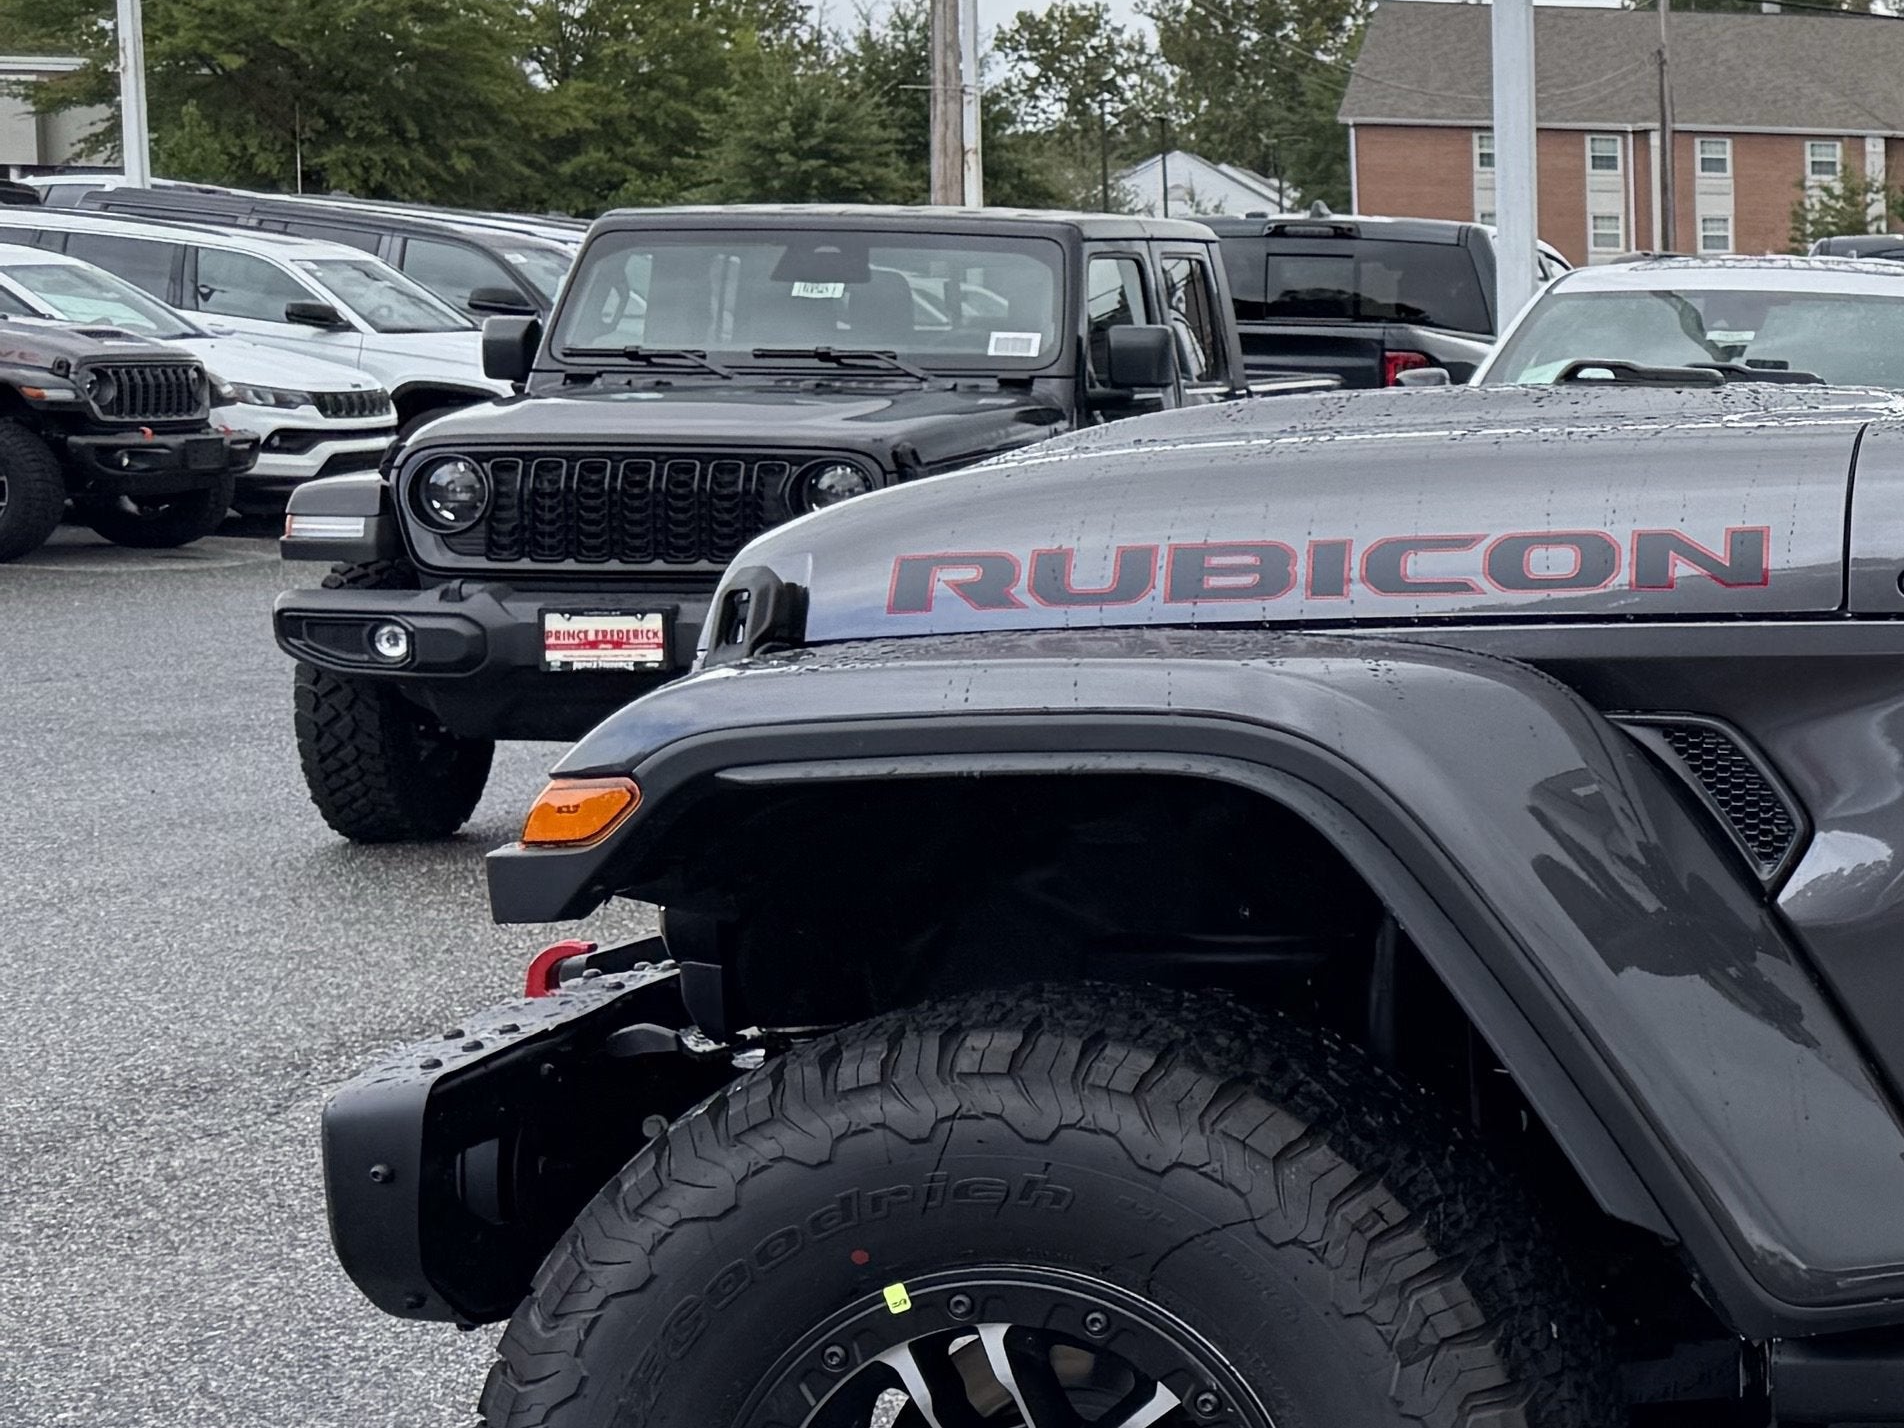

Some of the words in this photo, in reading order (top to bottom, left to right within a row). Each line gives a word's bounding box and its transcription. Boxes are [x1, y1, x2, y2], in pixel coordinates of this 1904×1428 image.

[886, 525, 1771, 614] RUBICON
[545, 629, 589, 642] PRINCE
[594, 629, 660, 642] FREDERICK
